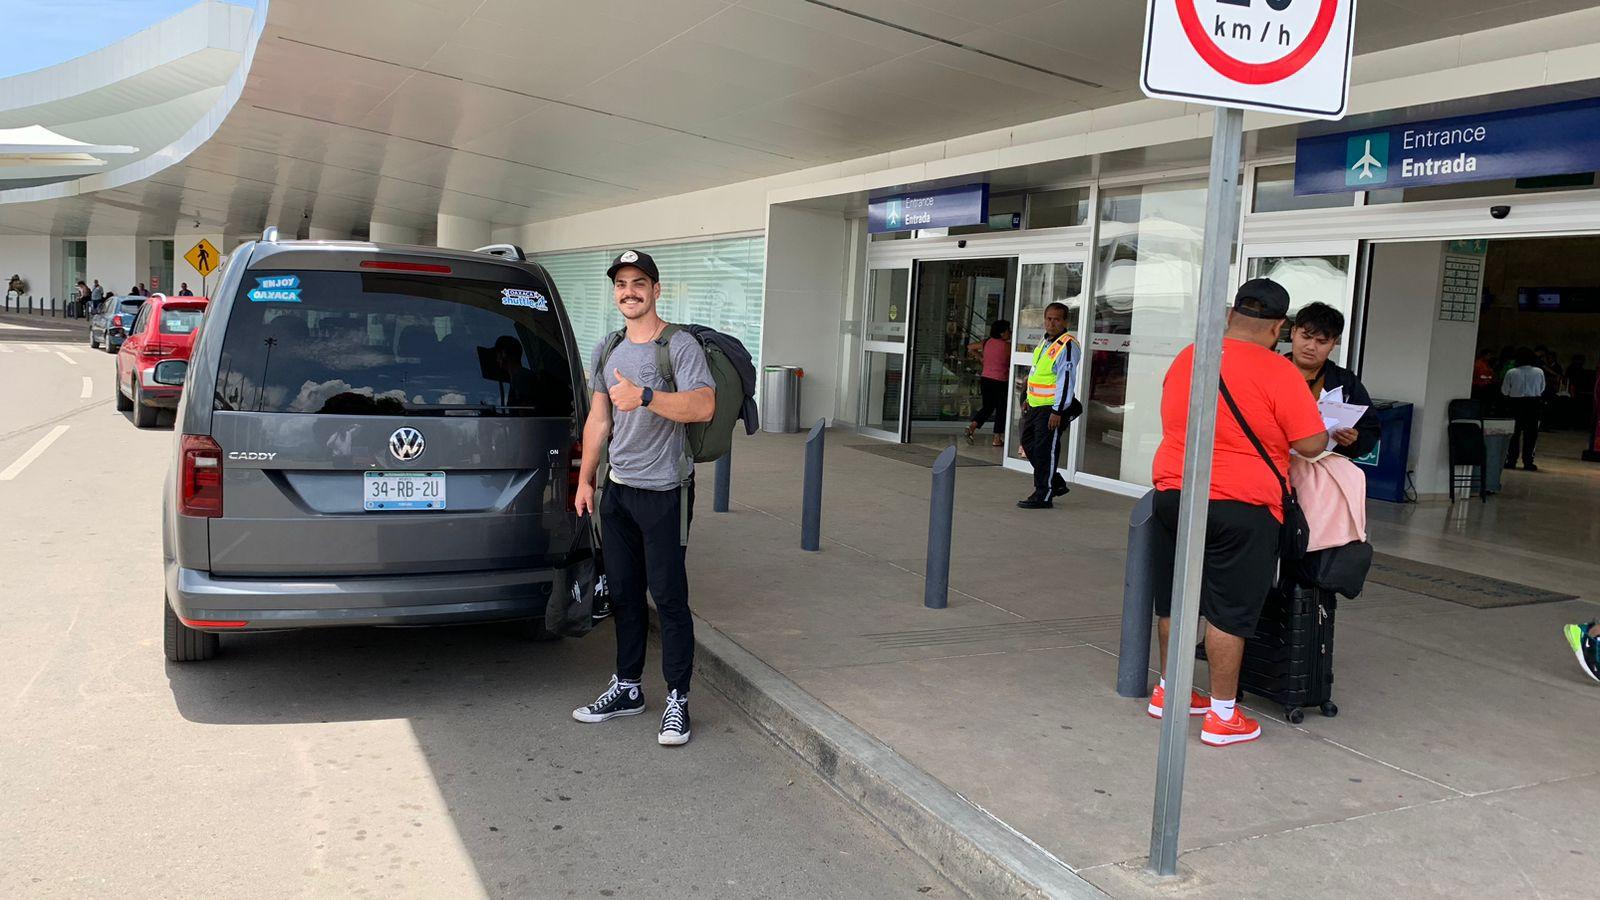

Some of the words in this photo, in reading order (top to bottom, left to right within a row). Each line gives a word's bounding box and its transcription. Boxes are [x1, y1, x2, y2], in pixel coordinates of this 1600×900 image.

[1214, 14, 1290, 46] km/h
[1403, 126, 1486, 149] Entrance
[1401, 153, 1477, 178] Entrada
[905, 197, 934, 209] Entrance
[905, 211, 931, 225] Entrada
[262, 277, 295, 289] ENJOY
[253, 290, 296, 300] OAXACA
[228, 451, 277, 460] CADDY
[371, 480, 439, 498] 34-RB-2U
